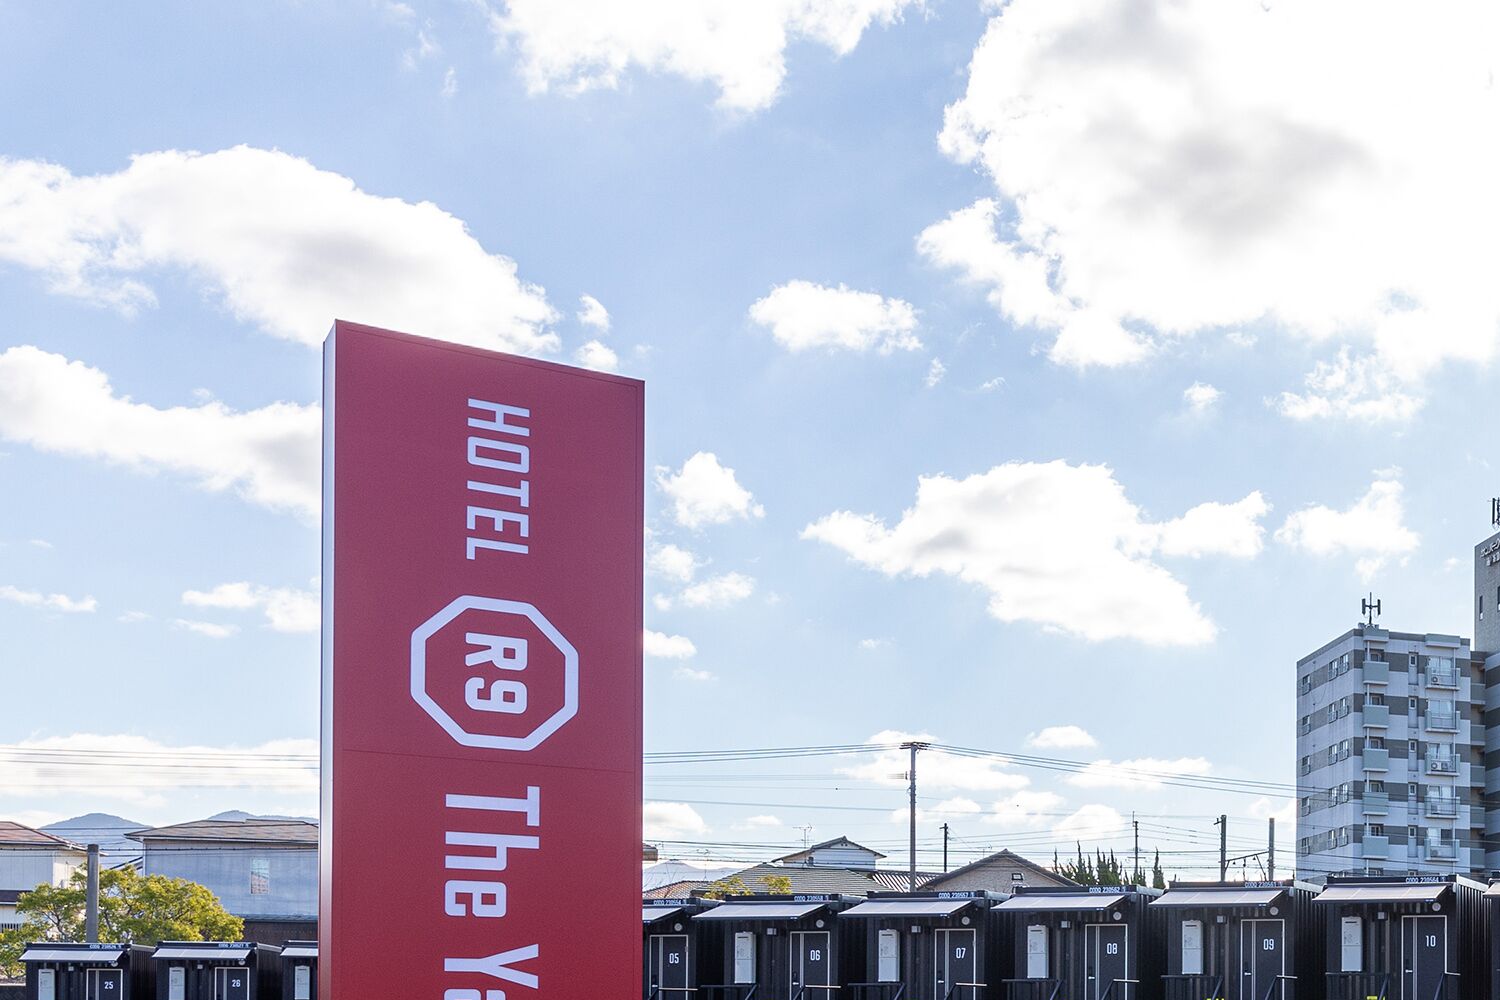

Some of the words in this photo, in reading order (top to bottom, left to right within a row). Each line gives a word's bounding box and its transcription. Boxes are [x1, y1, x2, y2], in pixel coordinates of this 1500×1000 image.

[465, 397, 530, 561] HOTEL
[464, 632, 528, 714] R9
[444, 784, 540, 919] The
[1263, 939, 1275, 951] 09
[1425, 935, 1436, 947] 10
[955, 947, 966, 959] 07
[1106, 943, 1118, 955] 08
[669, 953, 680, 964] 05
[810, 950, 821, 961] 06
[104, 981, 114, 990] 25
[231, 979, 241, 988] 26
